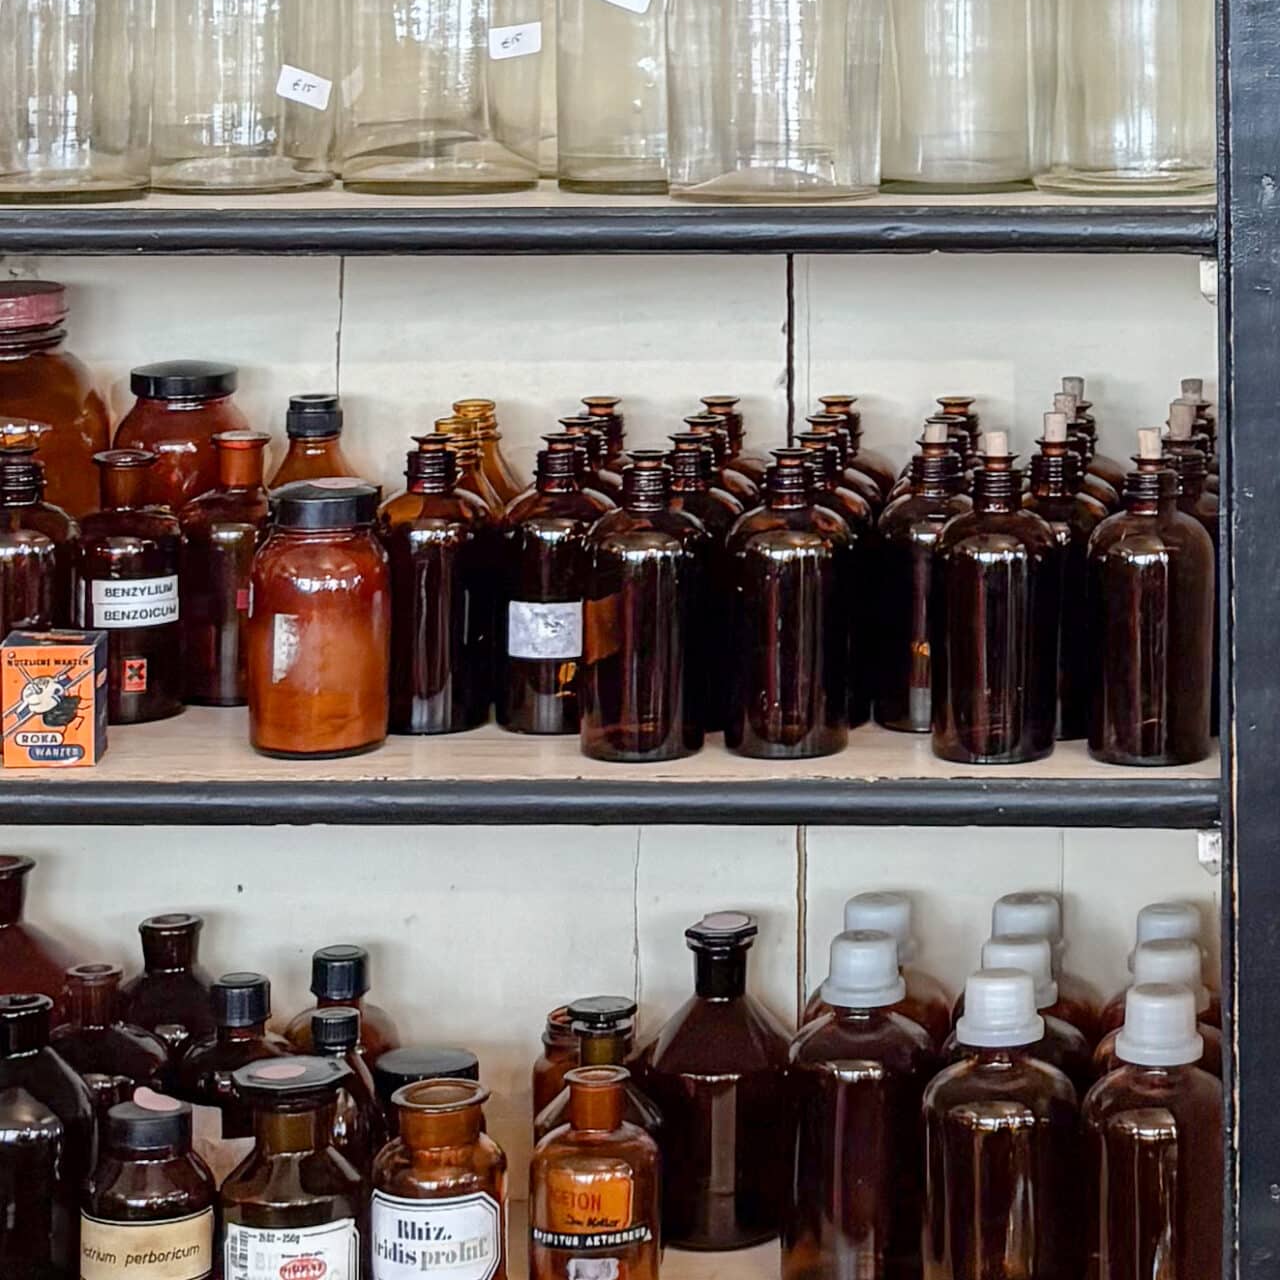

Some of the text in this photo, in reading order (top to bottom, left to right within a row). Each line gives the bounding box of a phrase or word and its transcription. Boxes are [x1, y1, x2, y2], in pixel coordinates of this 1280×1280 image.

[103, 581, 174, 598] BENZYLIUM
[103, 604, 177, 621] BENZOICUM
[21, 733, 59, 744] ROKA
[397, 1218, 453, 1241] Rhiz.
[124, 1244, 200, 1268] perboricum
